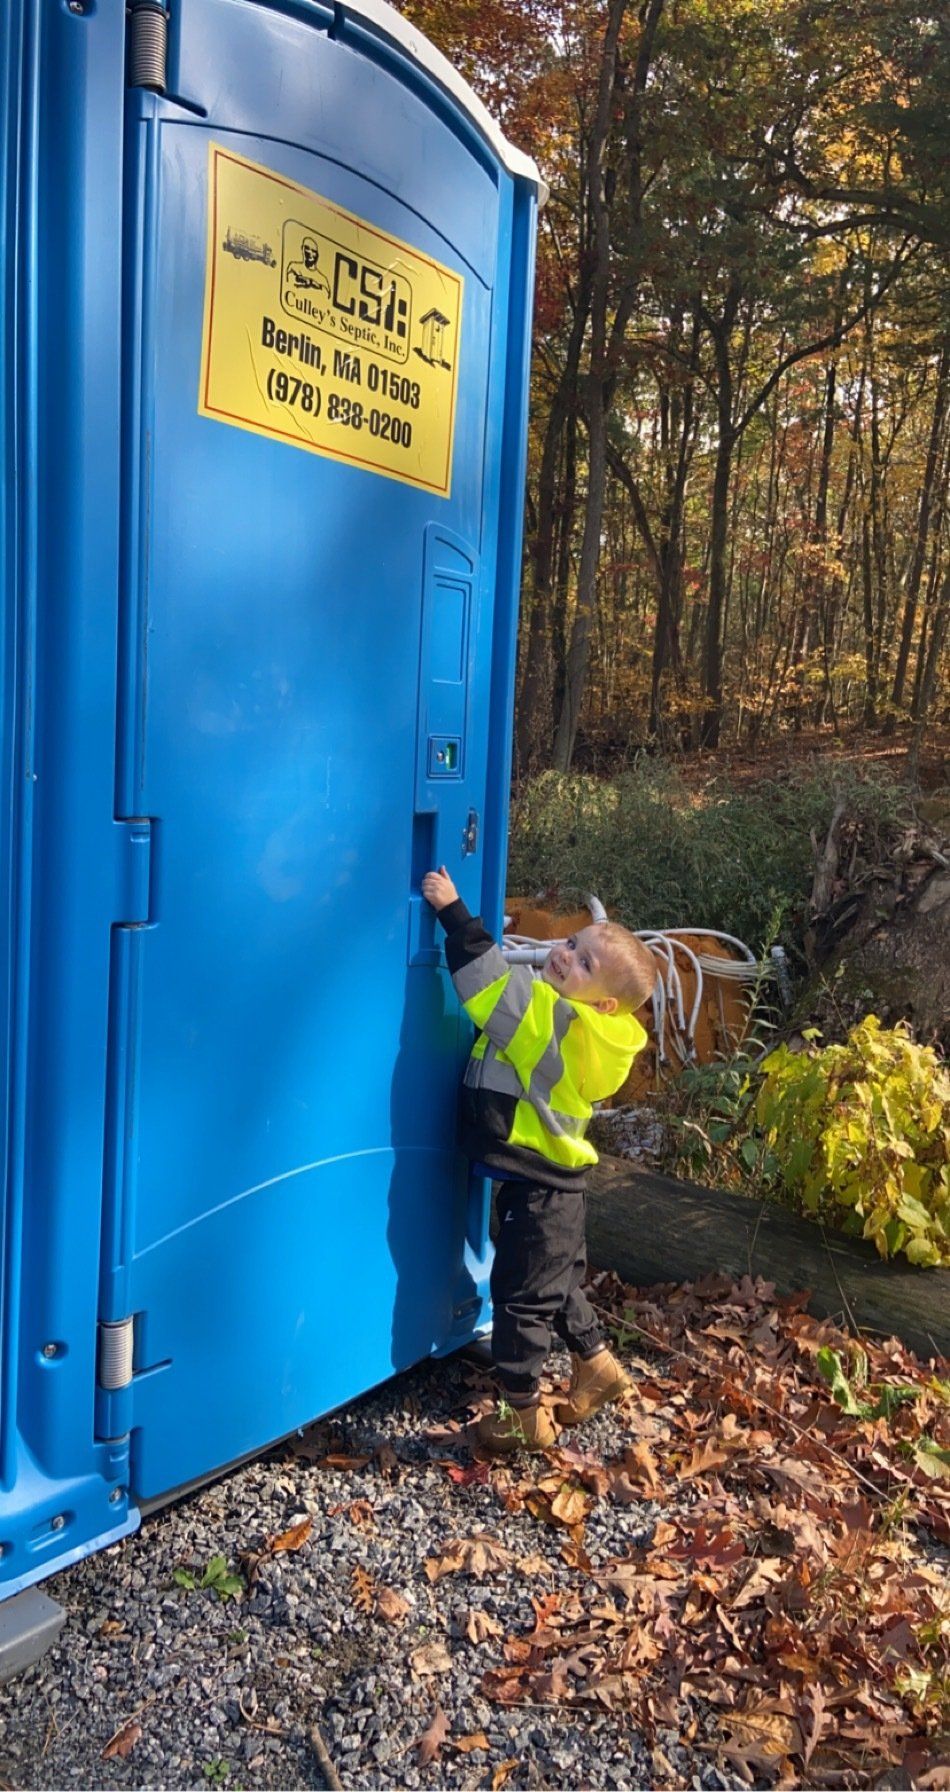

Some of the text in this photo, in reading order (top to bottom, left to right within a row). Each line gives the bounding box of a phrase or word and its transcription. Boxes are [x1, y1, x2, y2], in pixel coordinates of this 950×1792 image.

[262, 316, 421, 409] Berlin, MA 01503
[285, 290, 405, 357] Culley's Septic, Inc.
[267, 368, 412, 448] (978) 838-0200
